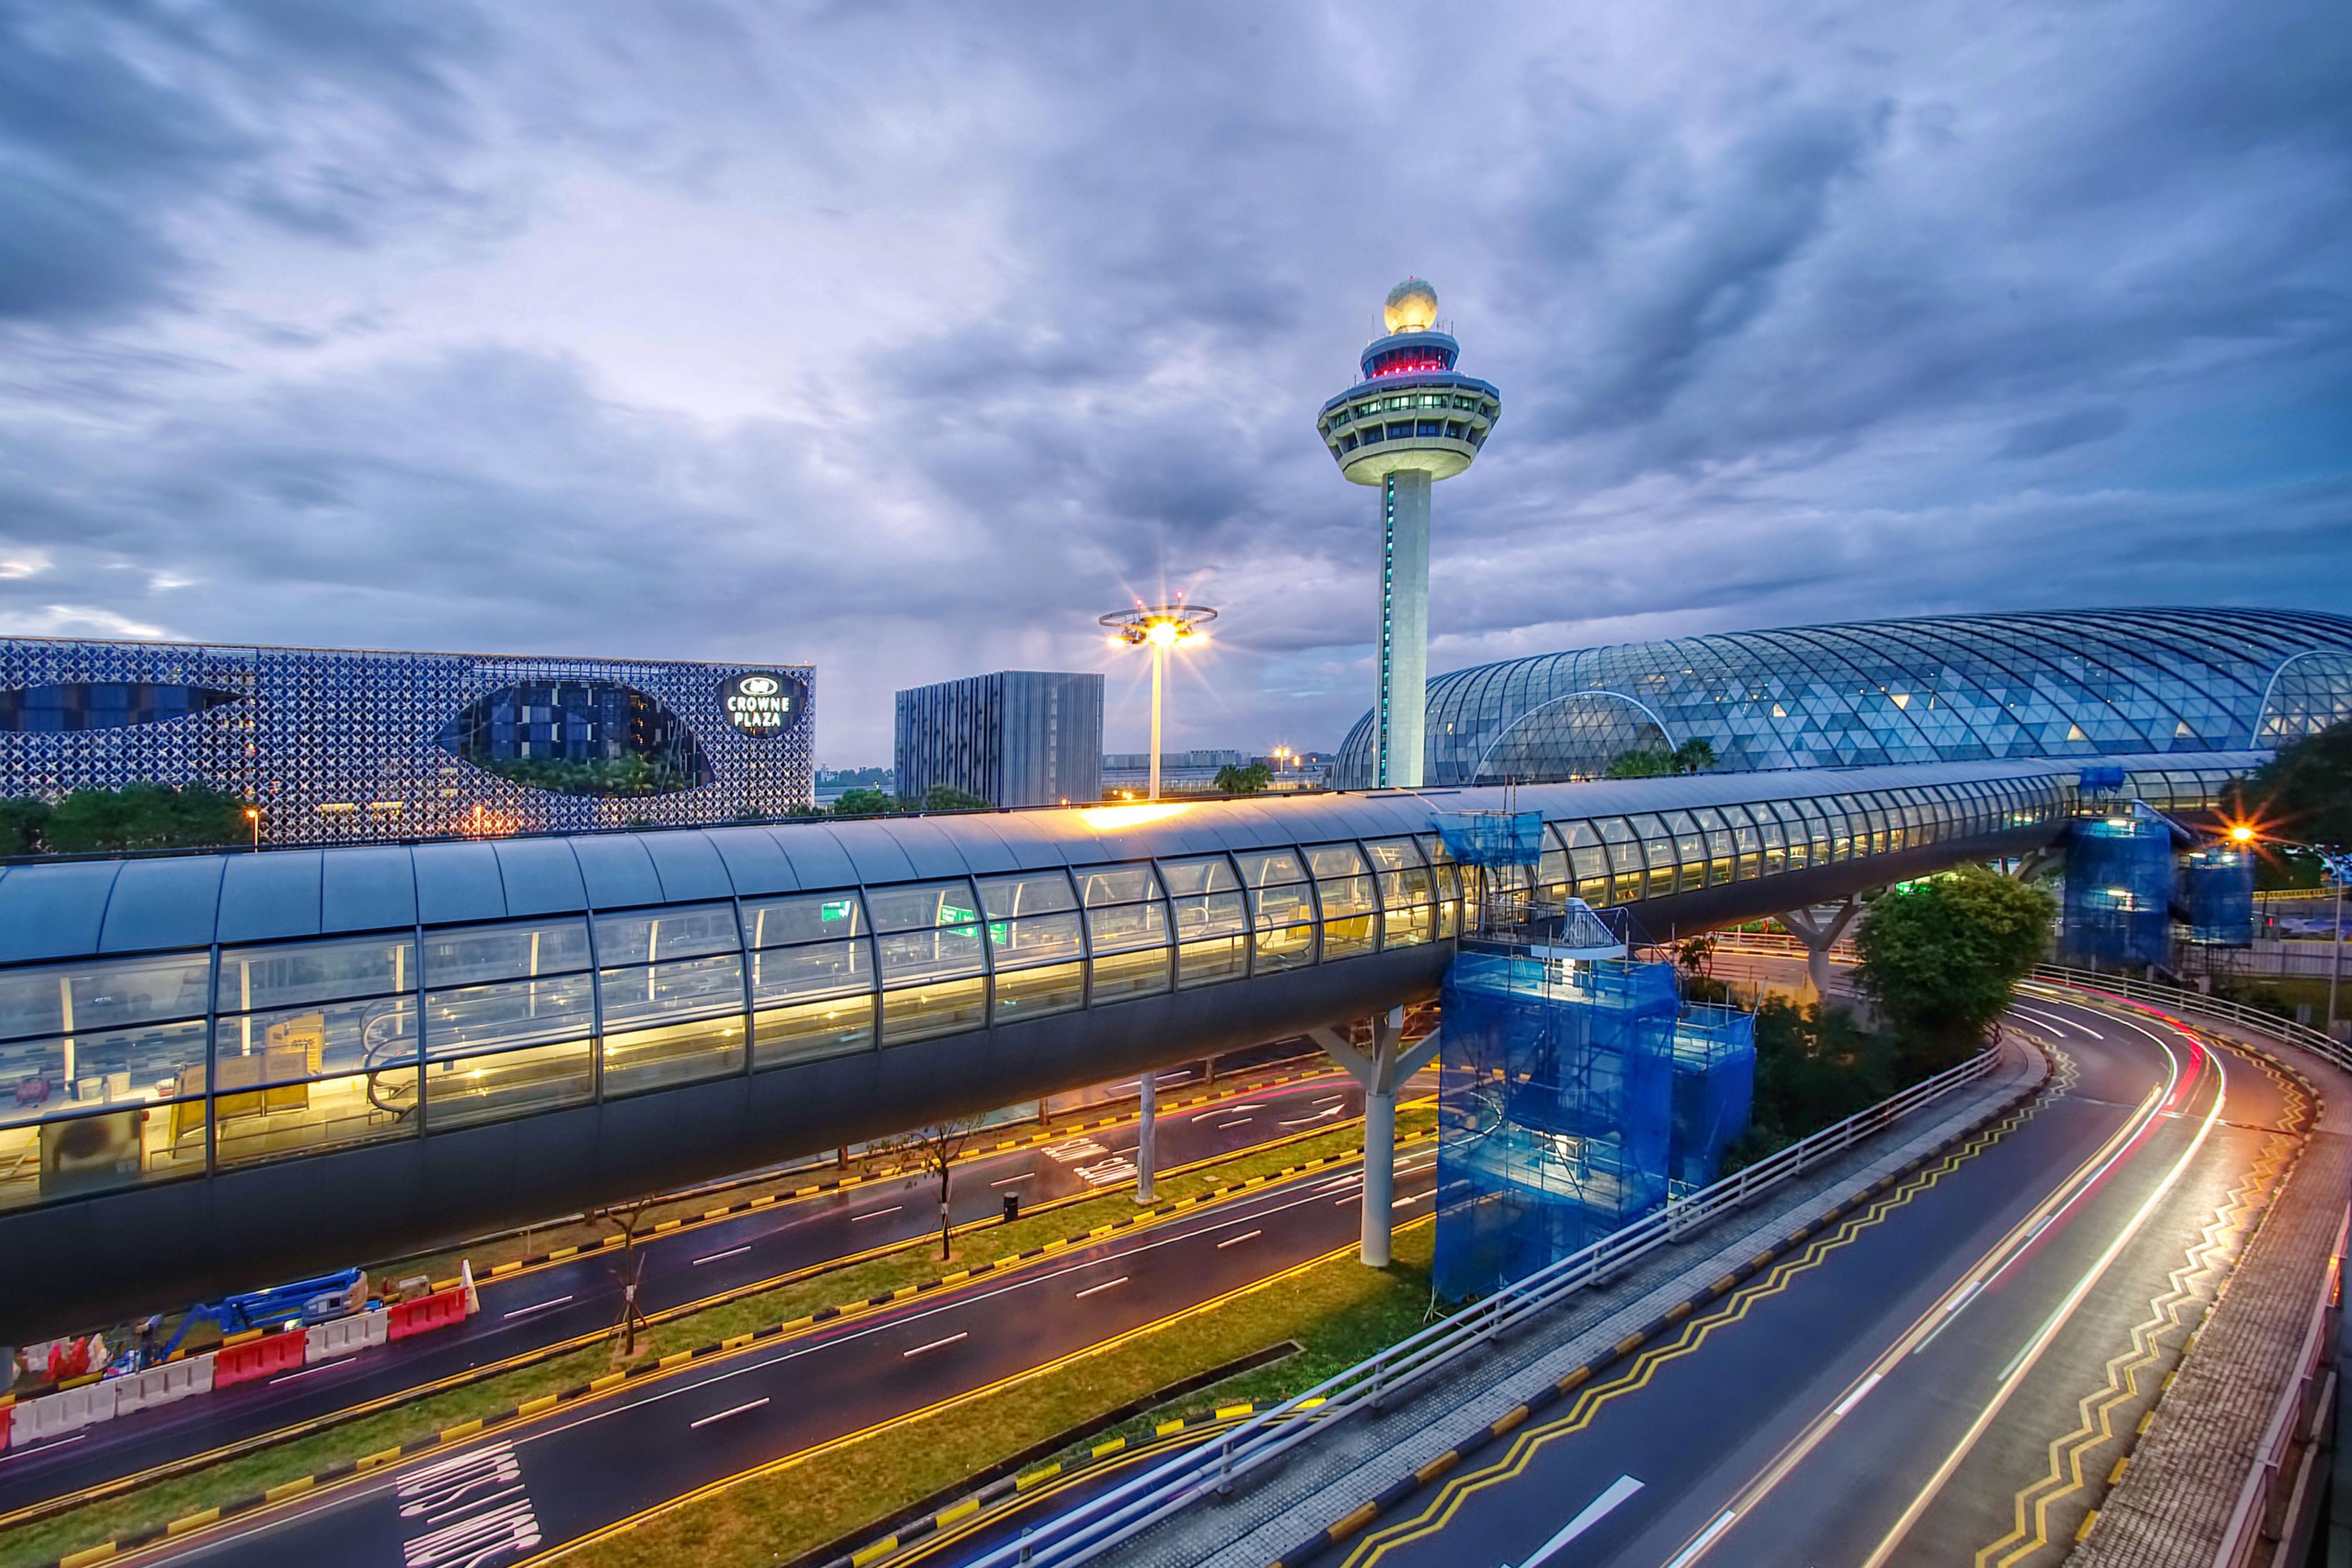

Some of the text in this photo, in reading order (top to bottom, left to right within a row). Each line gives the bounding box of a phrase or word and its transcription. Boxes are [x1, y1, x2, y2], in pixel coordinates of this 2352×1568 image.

[727, 696, 790, 712] CROWNE
[734, 712, 781, 727] PLAZA
[396, 1439, 522, 1517] SLOW
